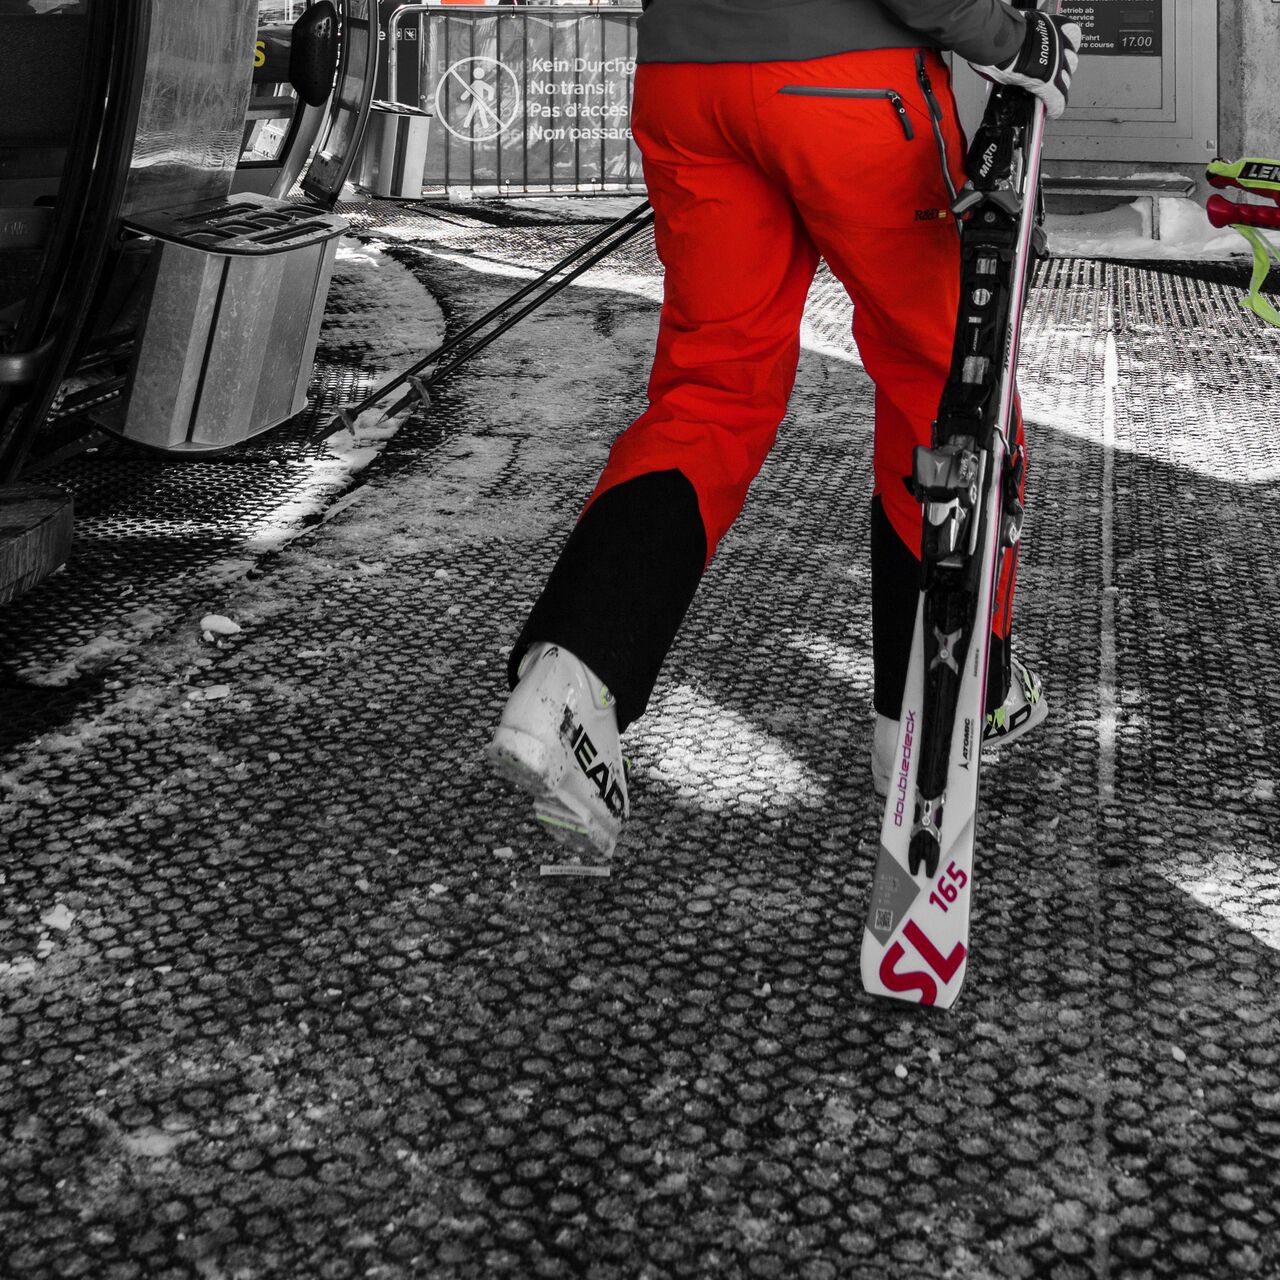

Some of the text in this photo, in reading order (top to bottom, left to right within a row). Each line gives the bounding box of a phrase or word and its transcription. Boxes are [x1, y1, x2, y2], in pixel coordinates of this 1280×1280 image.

[1036, 20, 1050, 66] snowlife
[1122, 36, 1152, 47] 17.00
[532, 58, 568, 73] Kein
[575, 58, 636, 76] Durchg
[530, 80, 615, 95] No transit
[530, 104, 560, 117] Pas
[530, 127, 565, 140] Non
[914, 208, 939, 221] R&D
[962, 718, 971, 761] ATOMIC
[894, 710, 916, 828] doubledeck
[929, 860, 968, 913] 165
[879, 919, 968, 1007] SL
